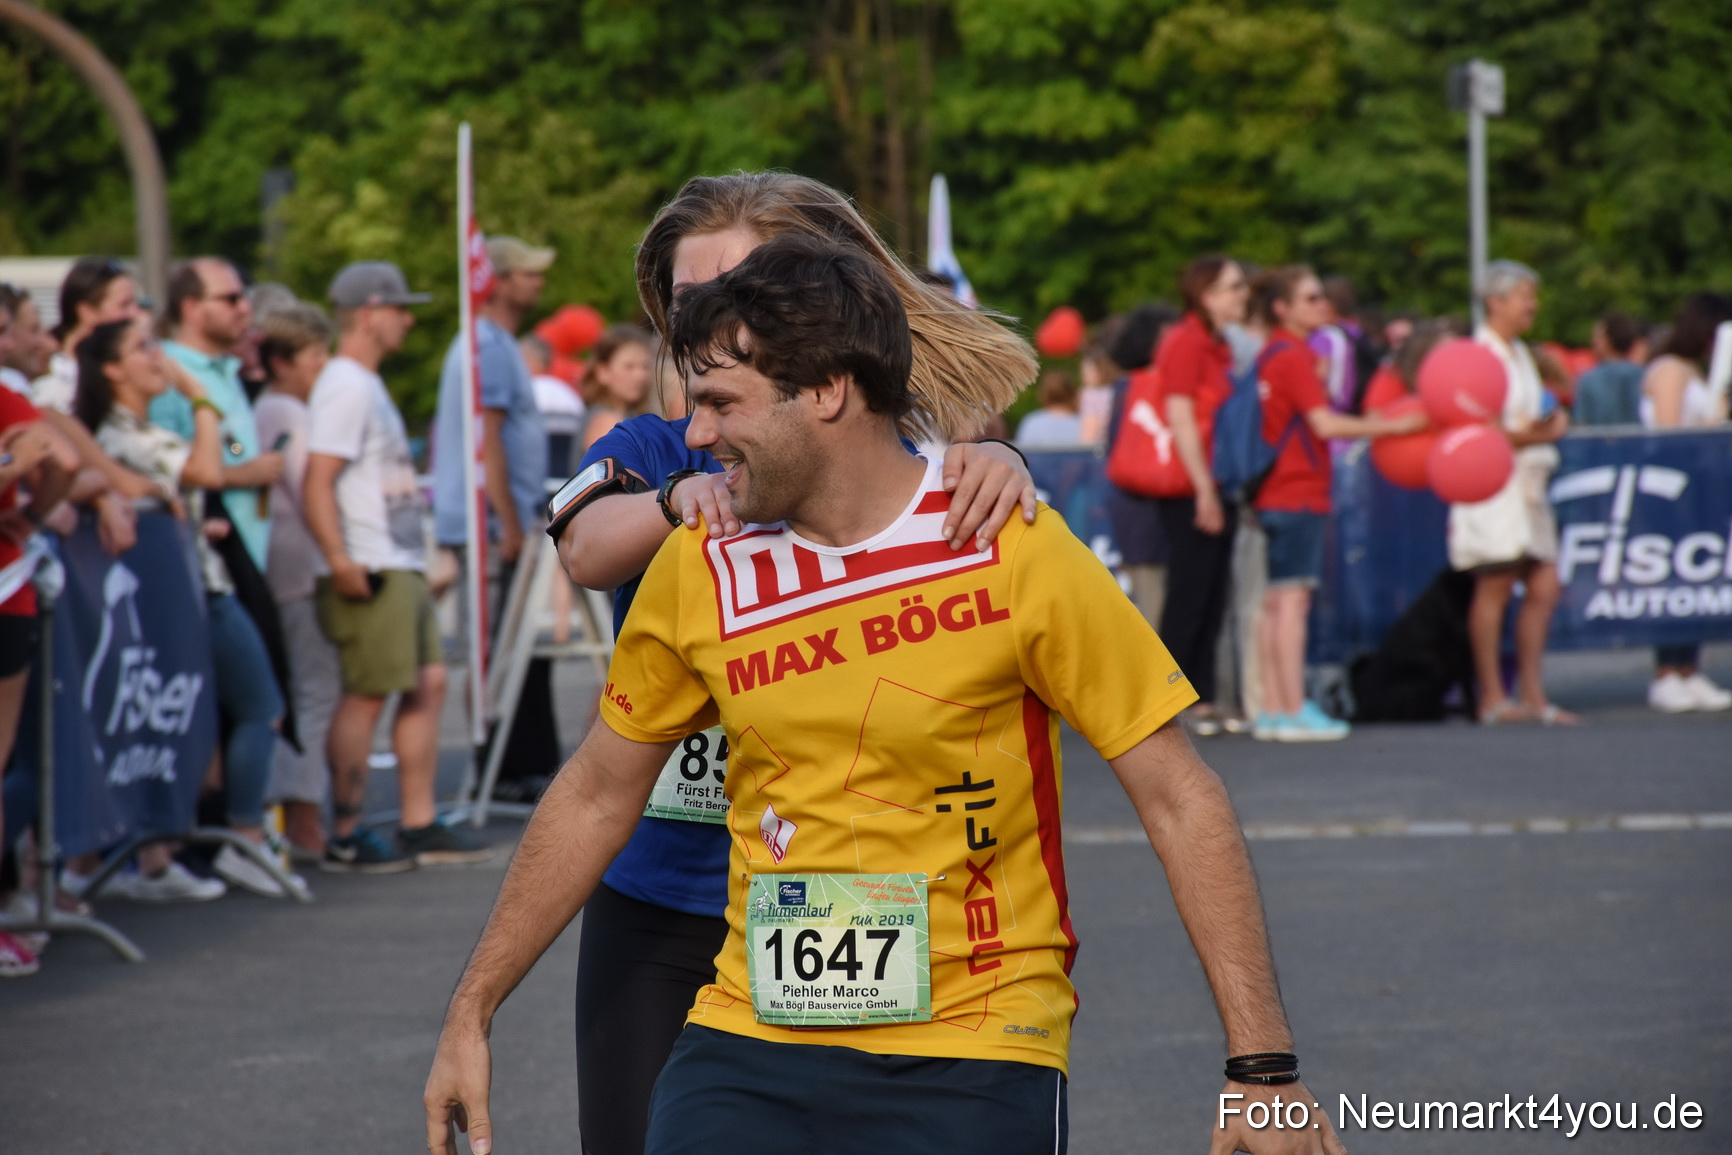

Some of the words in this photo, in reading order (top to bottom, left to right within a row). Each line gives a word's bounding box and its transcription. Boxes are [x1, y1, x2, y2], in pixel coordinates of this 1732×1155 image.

[1557, 519, 1732, 585] Fisc
[725, 627, 847, 696] MAX
[860, 587, 1009, 656] BÖGL
[605, 682, 633, 715] l.de
[677, 782, 710, 798] Fürst
[684, 798, 703, 809] Fritz
[768, 903, 834, 917] firmenlauf
[879, 914, 915, 926] 2019
[765, 928, 900, 982] 1647
[783, 985, 829, 997] Piehler
[833, 985, 879, 998] Marco
[770, 1000, 784, 1009] Max
[786, 1000, 805, 1012] Bögl
[808, 1000, 863, 1010] Bauservice
[866, 999, 898, 1009] GmbH
